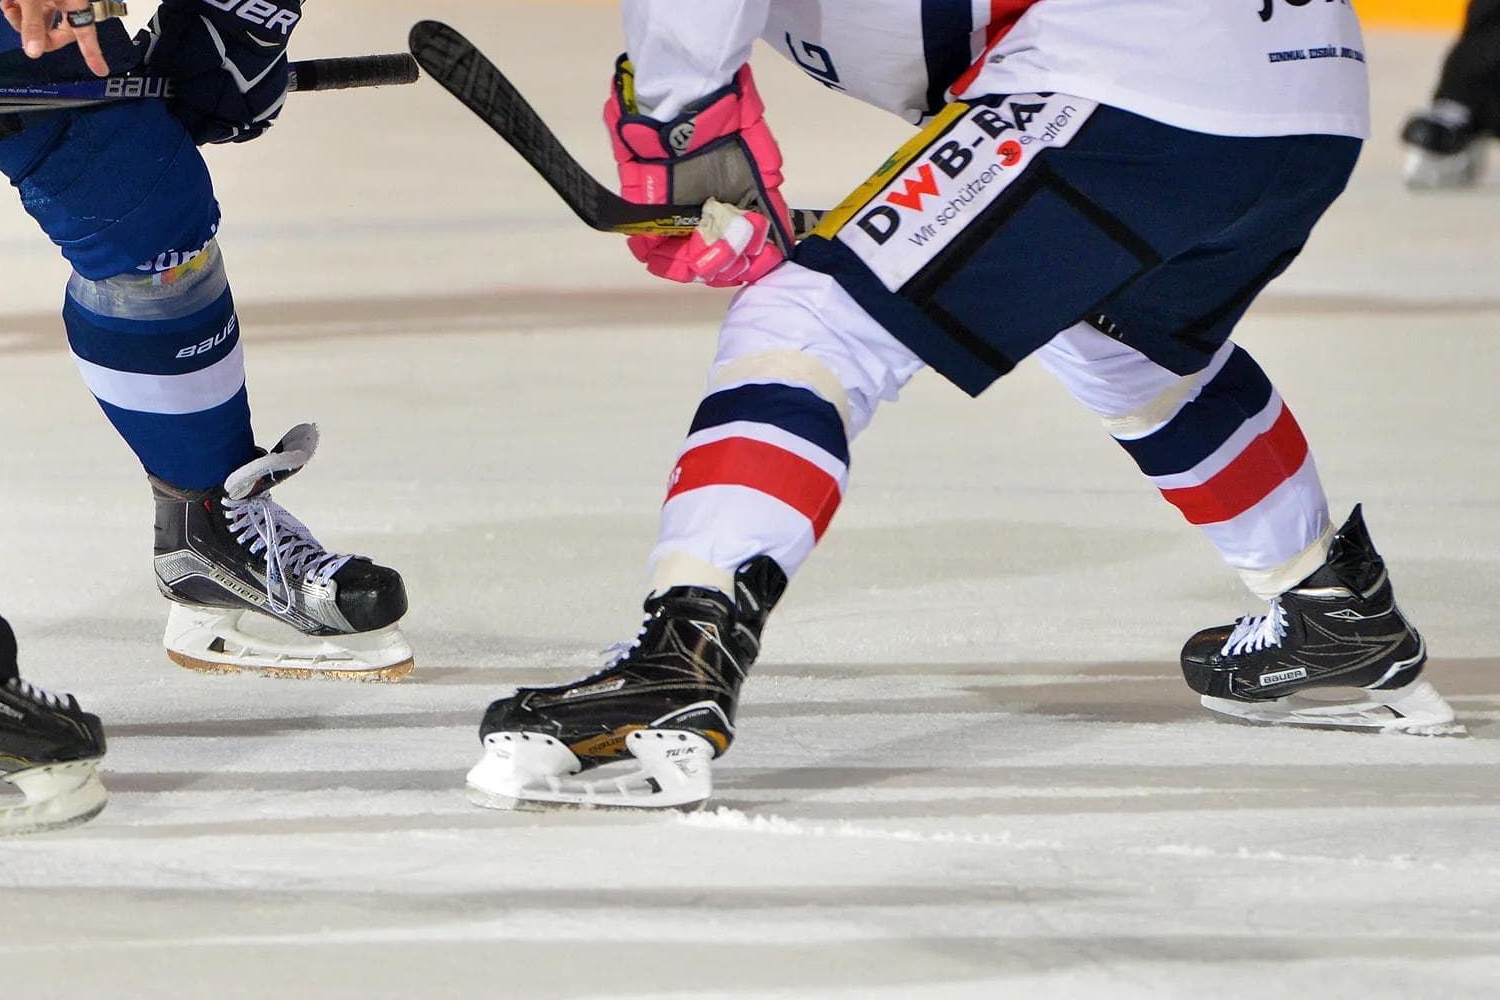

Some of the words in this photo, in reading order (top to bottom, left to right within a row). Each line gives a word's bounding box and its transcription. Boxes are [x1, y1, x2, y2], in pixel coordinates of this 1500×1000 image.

[908, 223, 935, 247] Wir
[937, 162, 1002, 227] schützen
[175, 312, 236, 359] BAUE
[1263, 670, 1302, 684] BAUER
